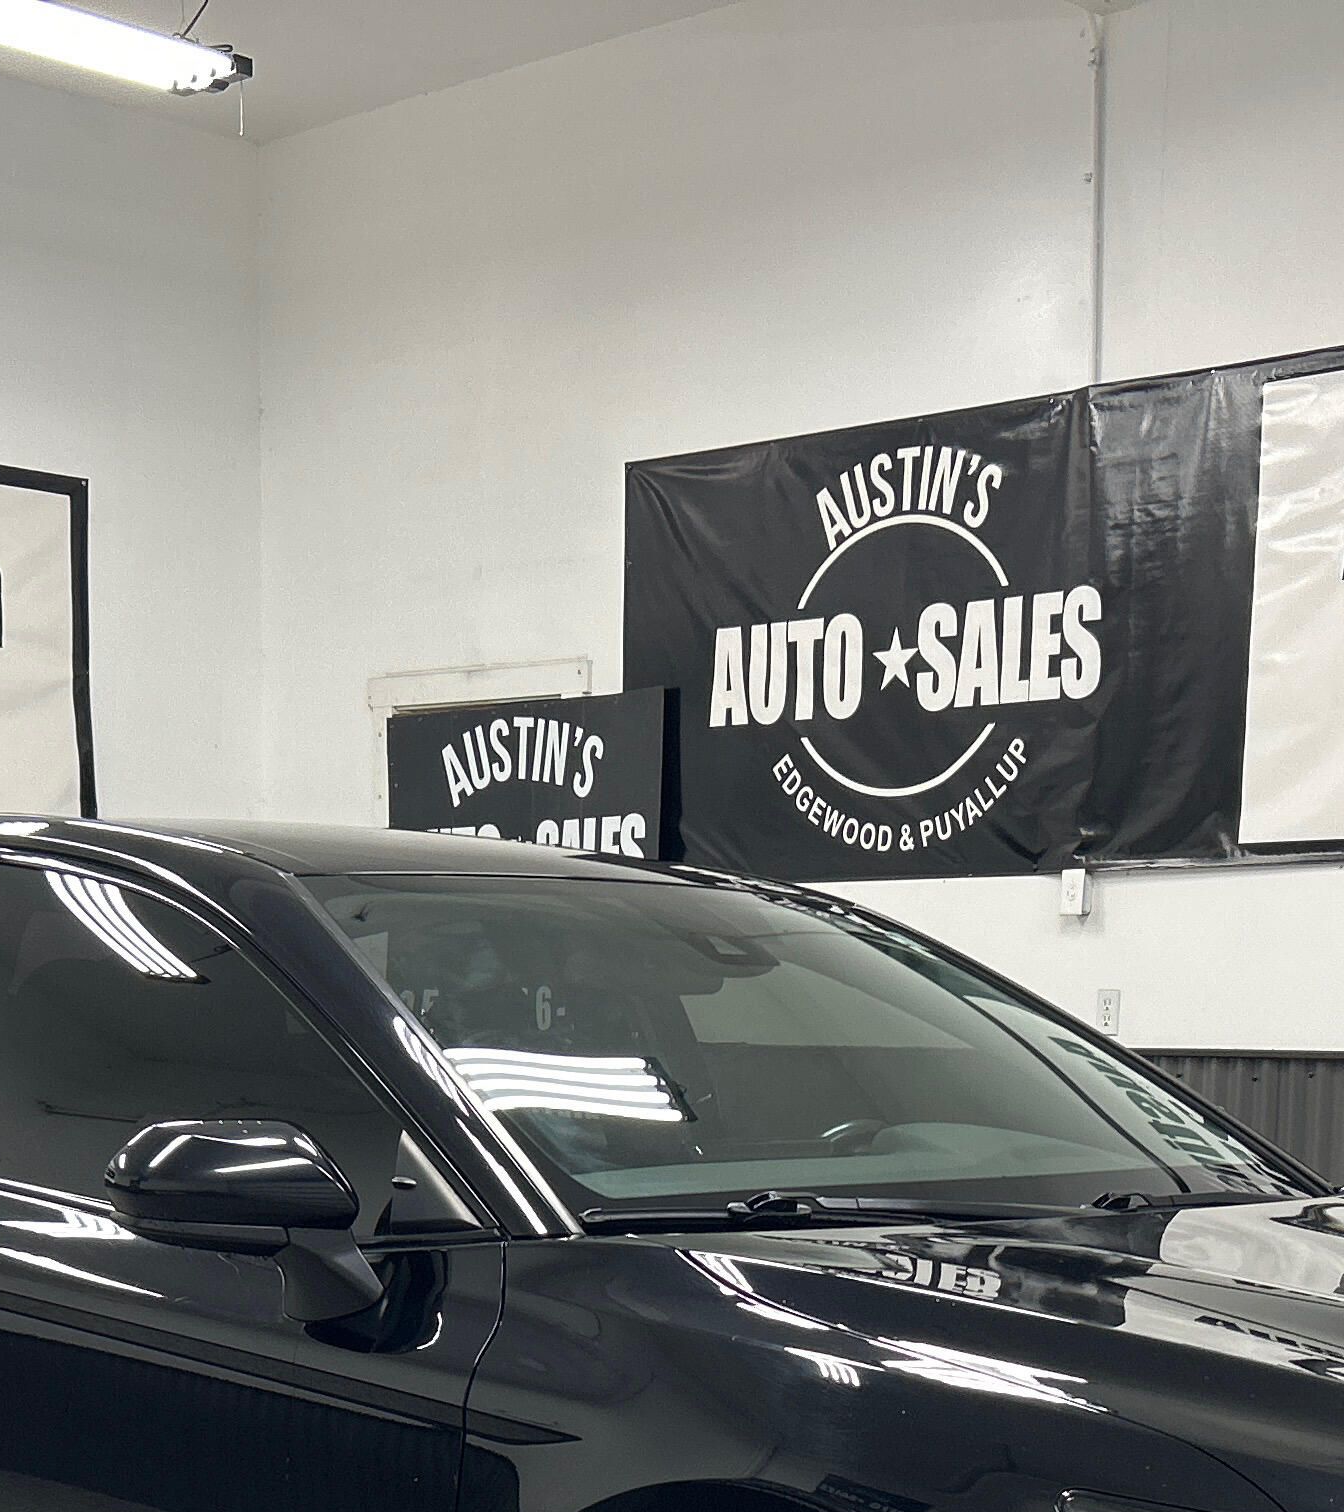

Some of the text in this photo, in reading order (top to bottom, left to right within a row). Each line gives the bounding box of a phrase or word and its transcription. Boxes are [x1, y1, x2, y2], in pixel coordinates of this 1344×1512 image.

[816, 446, 1002, 552] AUSTIN'S
[709, 585, 1102, 728] AUTO SALES
[441, 716, 606, 807] AUSTIN'S
[772, 737, 1030, 852] EDGEWOOD & PUYALLUP
